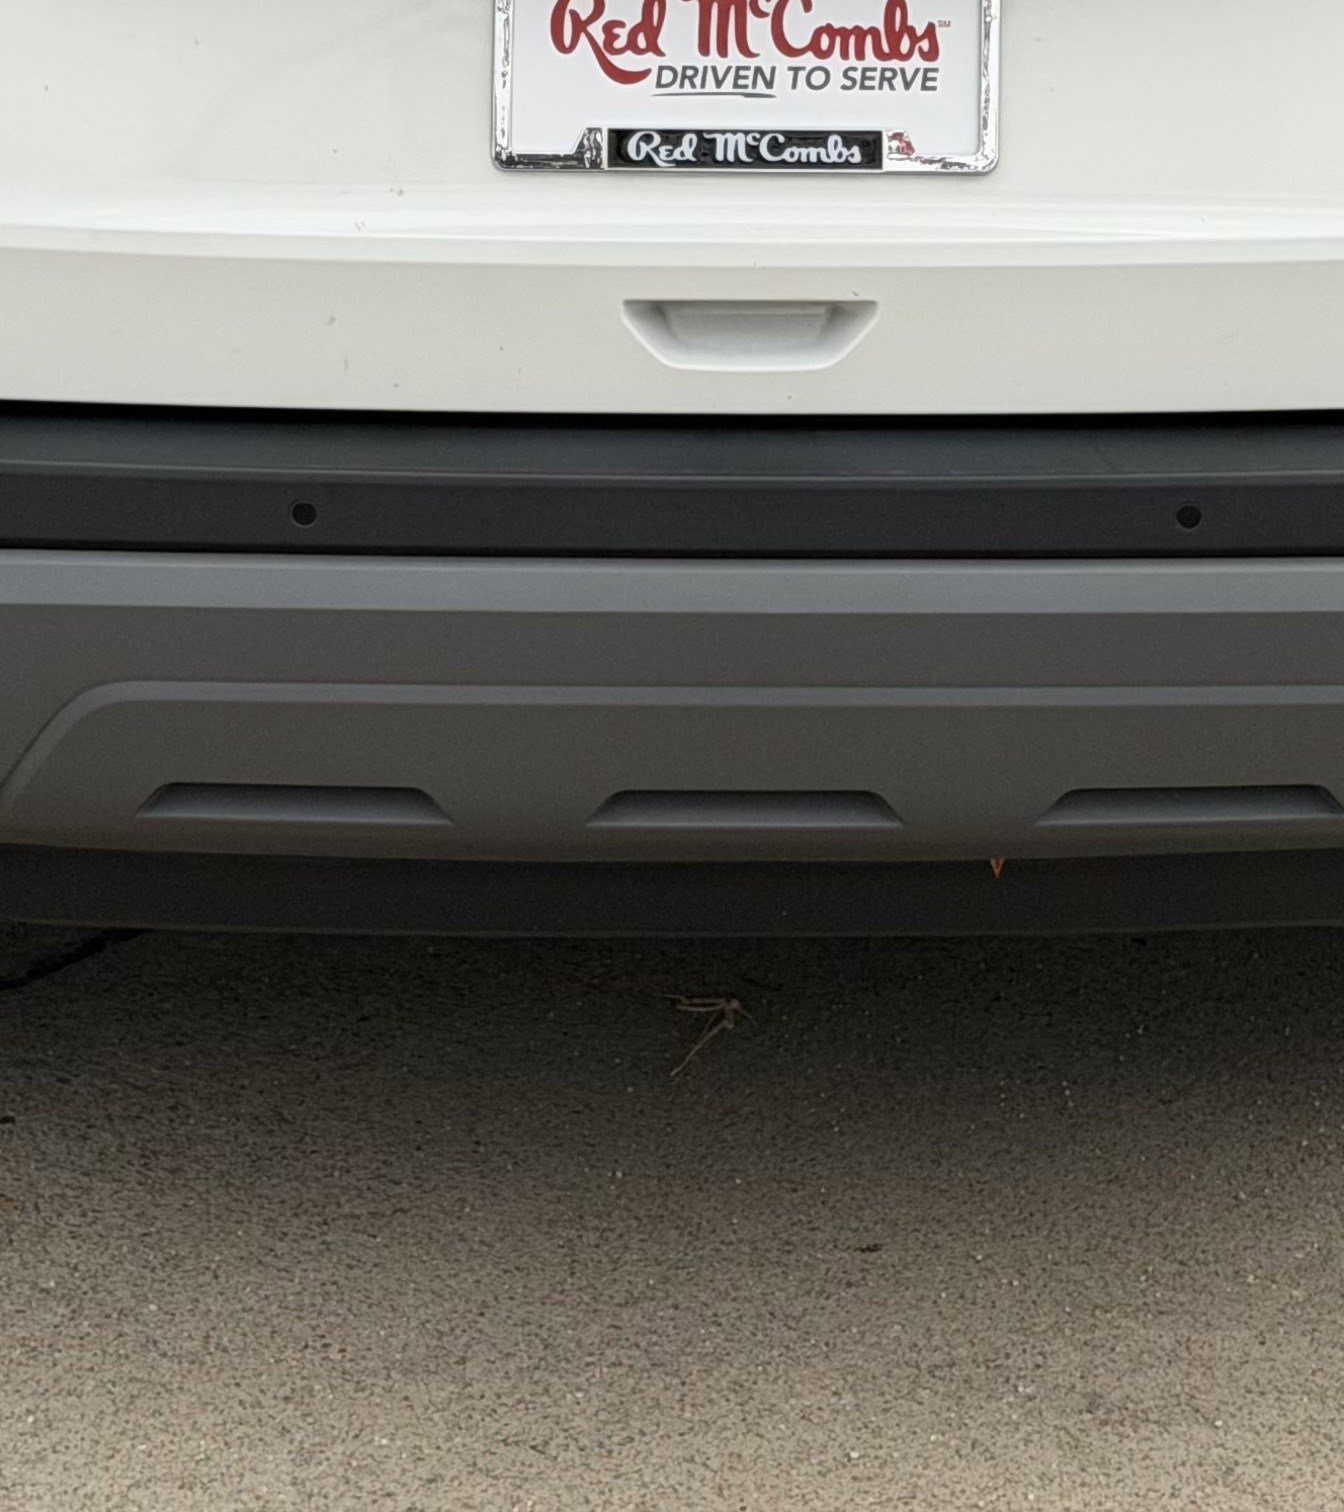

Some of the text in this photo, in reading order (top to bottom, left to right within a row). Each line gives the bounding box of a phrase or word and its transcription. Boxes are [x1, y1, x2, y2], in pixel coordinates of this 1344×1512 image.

[655, 65, 941, 92] DRIVEN TO SERVE
[626, 131, 863, 168] Red McCombs
